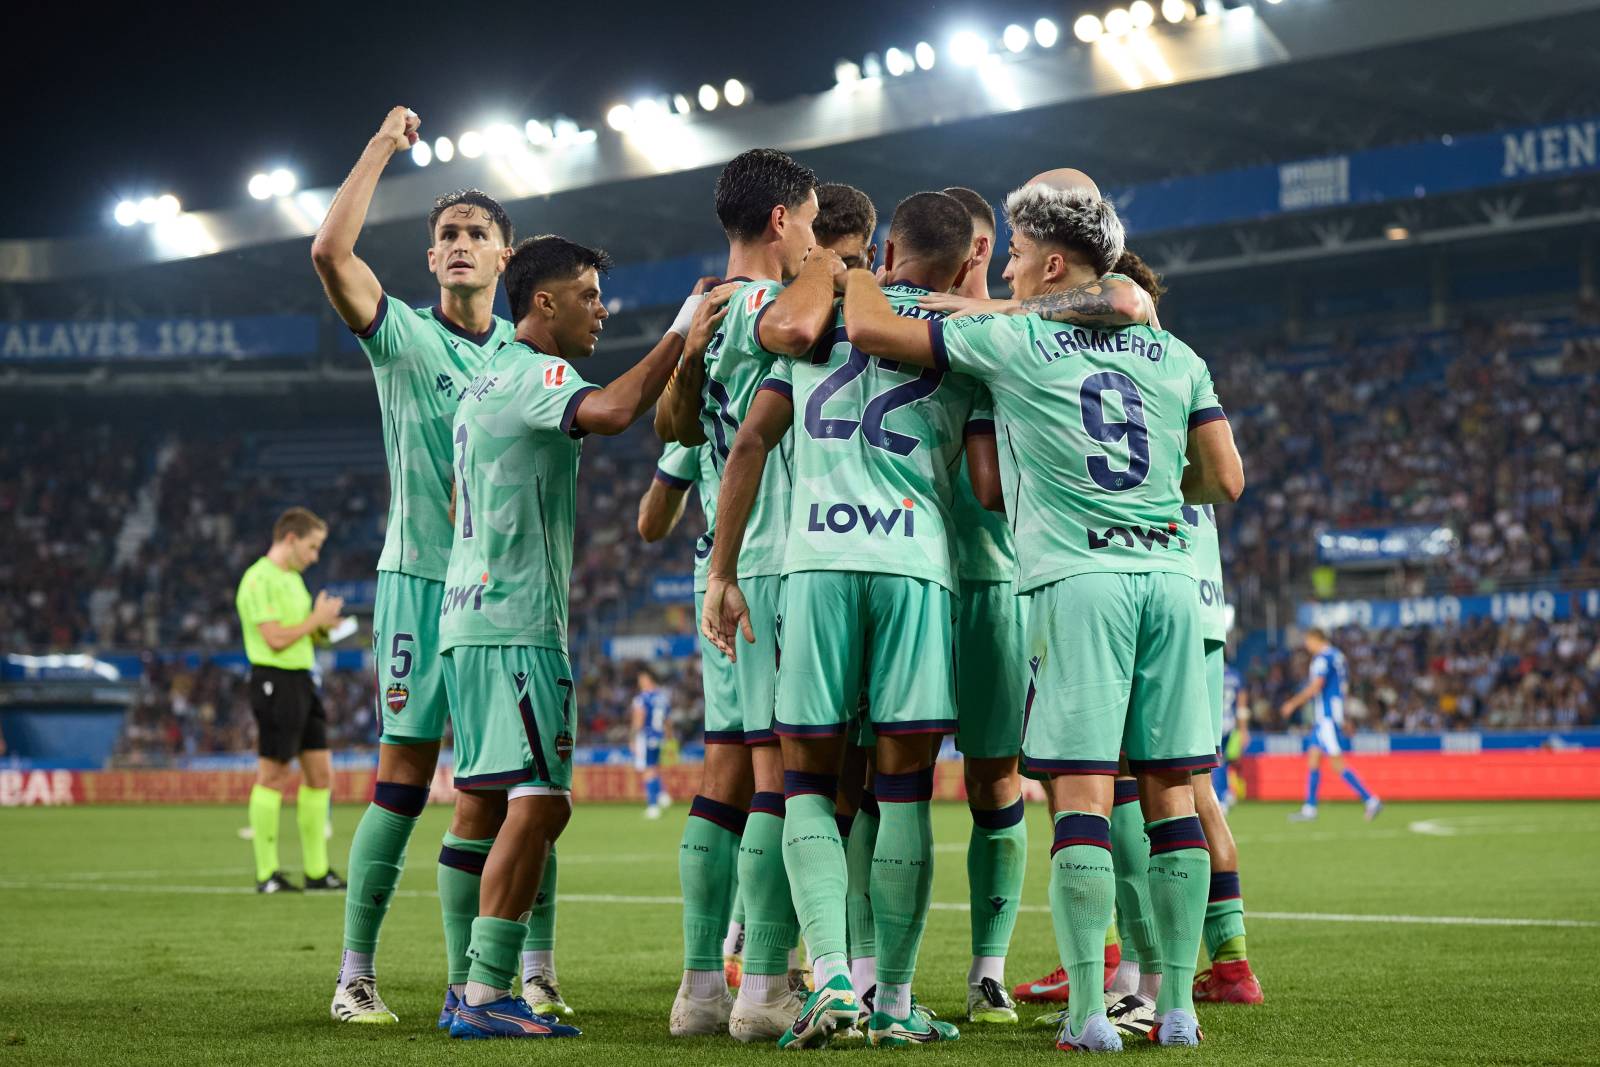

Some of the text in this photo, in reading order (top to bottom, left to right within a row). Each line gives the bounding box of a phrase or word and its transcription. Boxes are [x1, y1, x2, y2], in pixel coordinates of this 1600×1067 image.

[1036, 328, 1163, 363] I.ROMERO
[804, 325, 945, 457] 22
[1080, 371, 1151, 492] 9
[390, 632, 414, 679] 5
[556, 677, 574, 727] 7
[1059, 862, 1111, 873] LEVANTE
